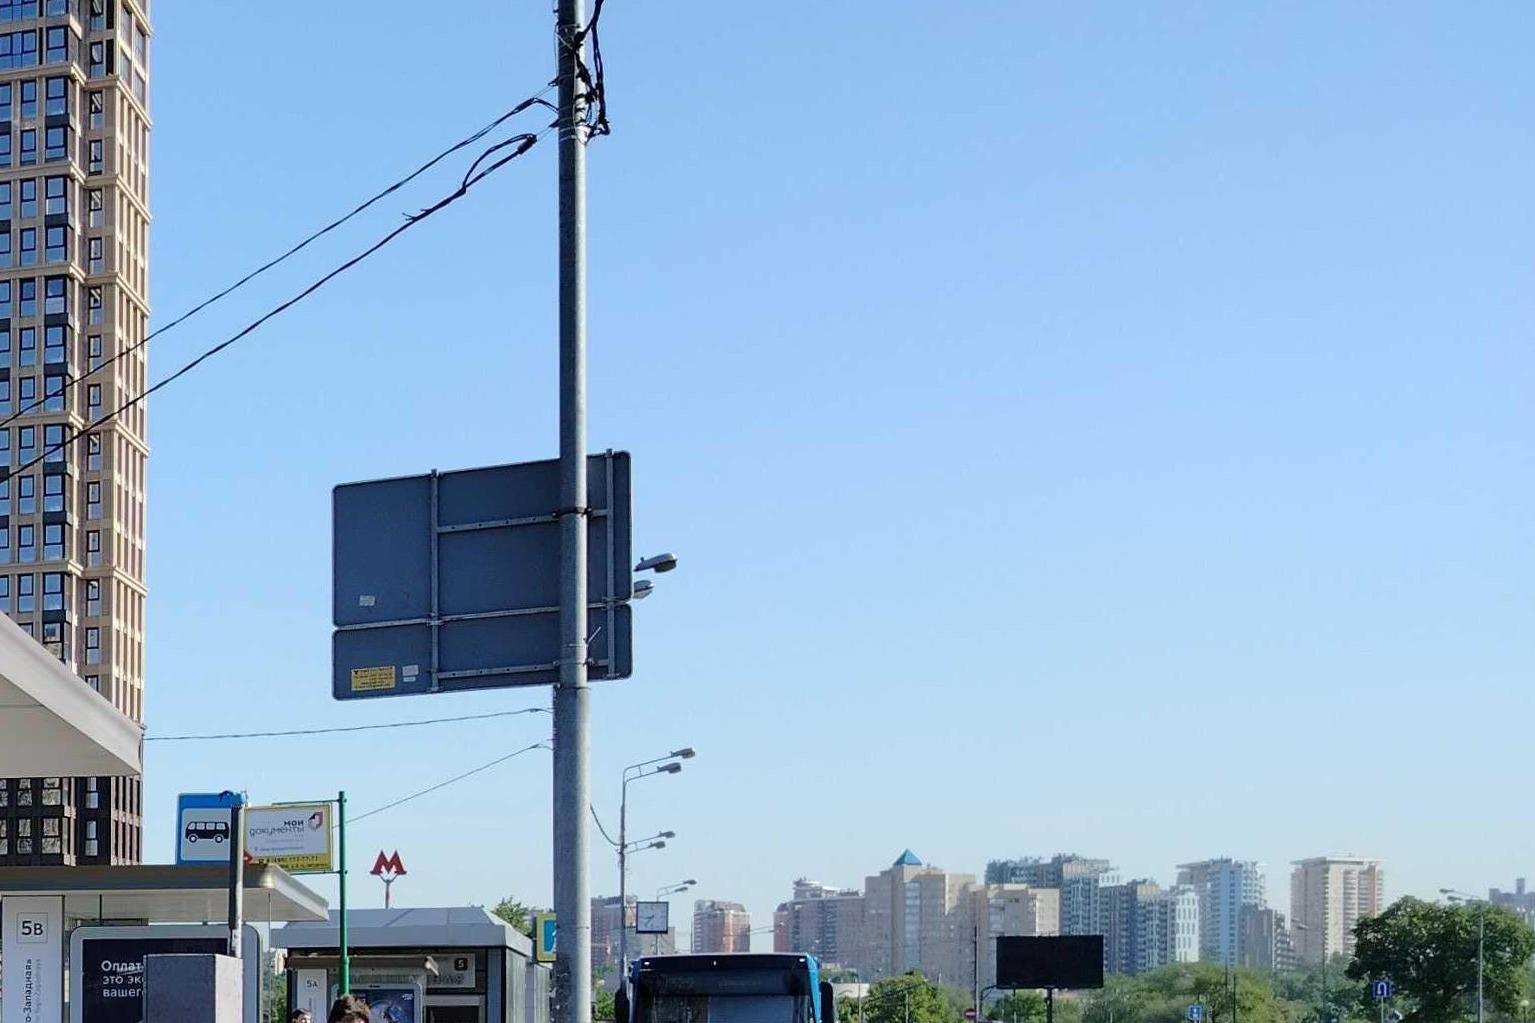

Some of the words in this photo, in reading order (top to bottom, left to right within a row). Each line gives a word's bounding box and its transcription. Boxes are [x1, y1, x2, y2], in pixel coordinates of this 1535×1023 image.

[21, 920, 44, 936] 5В
[102, 976, 123, 984] это
[103, 988, 144, 997] вашег
